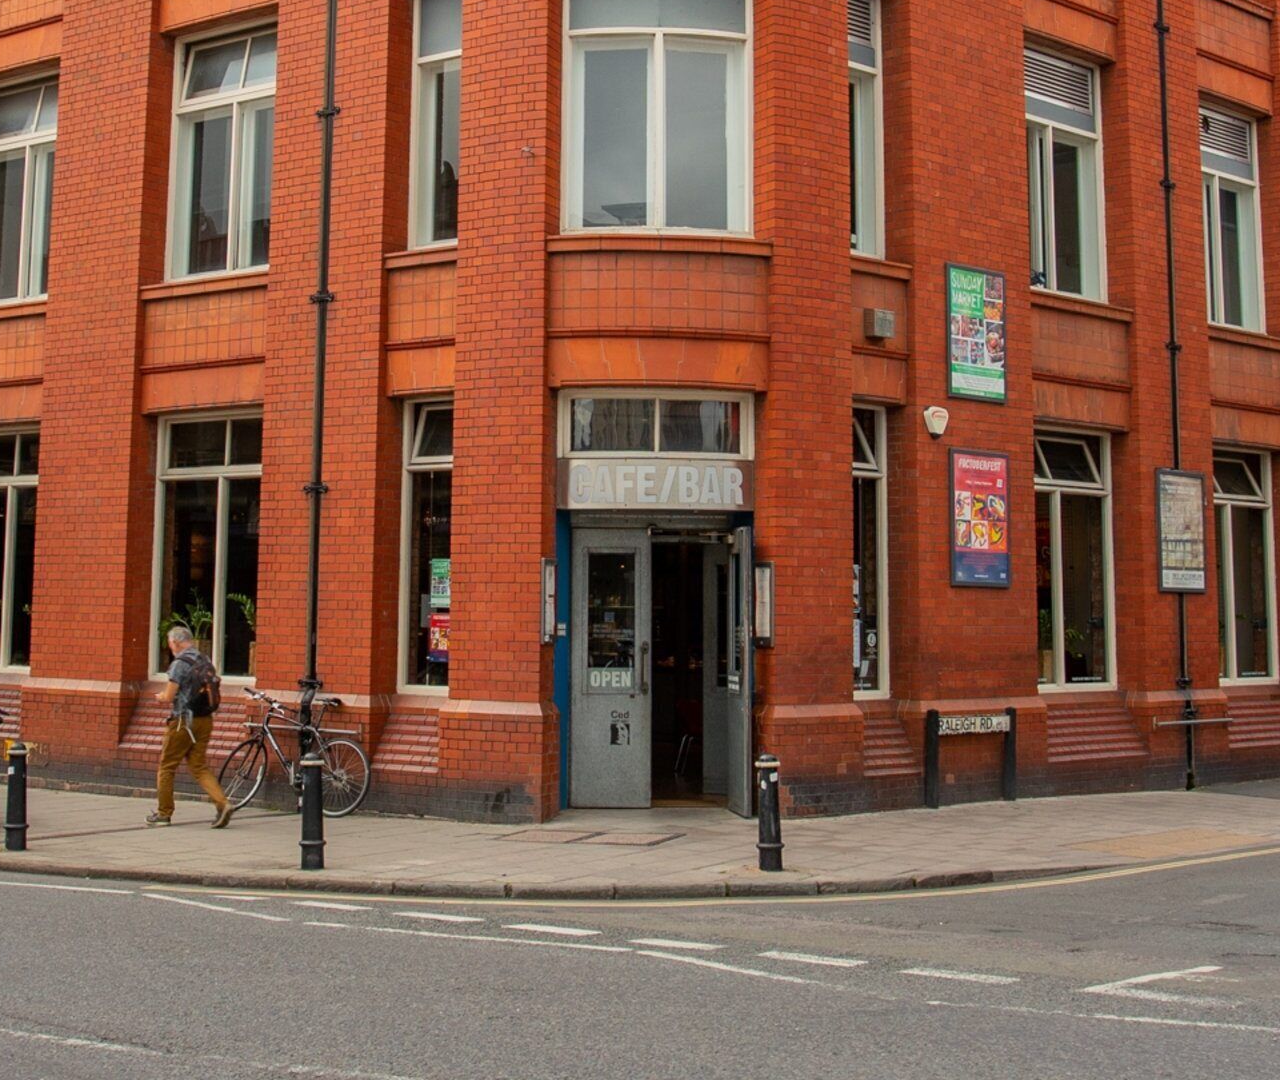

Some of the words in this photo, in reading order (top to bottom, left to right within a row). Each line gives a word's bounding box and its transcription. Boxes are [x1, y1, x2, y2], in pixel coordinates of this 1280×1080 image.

[951, 271, 983, 293] SUNDAY
[951, 288, 982, 309] MARKET
[570, 464, 744, 506] CAFE/BAR
[589, 670, 632, 688] OPEN
[939, 717, 977, 732] RALEIGH
